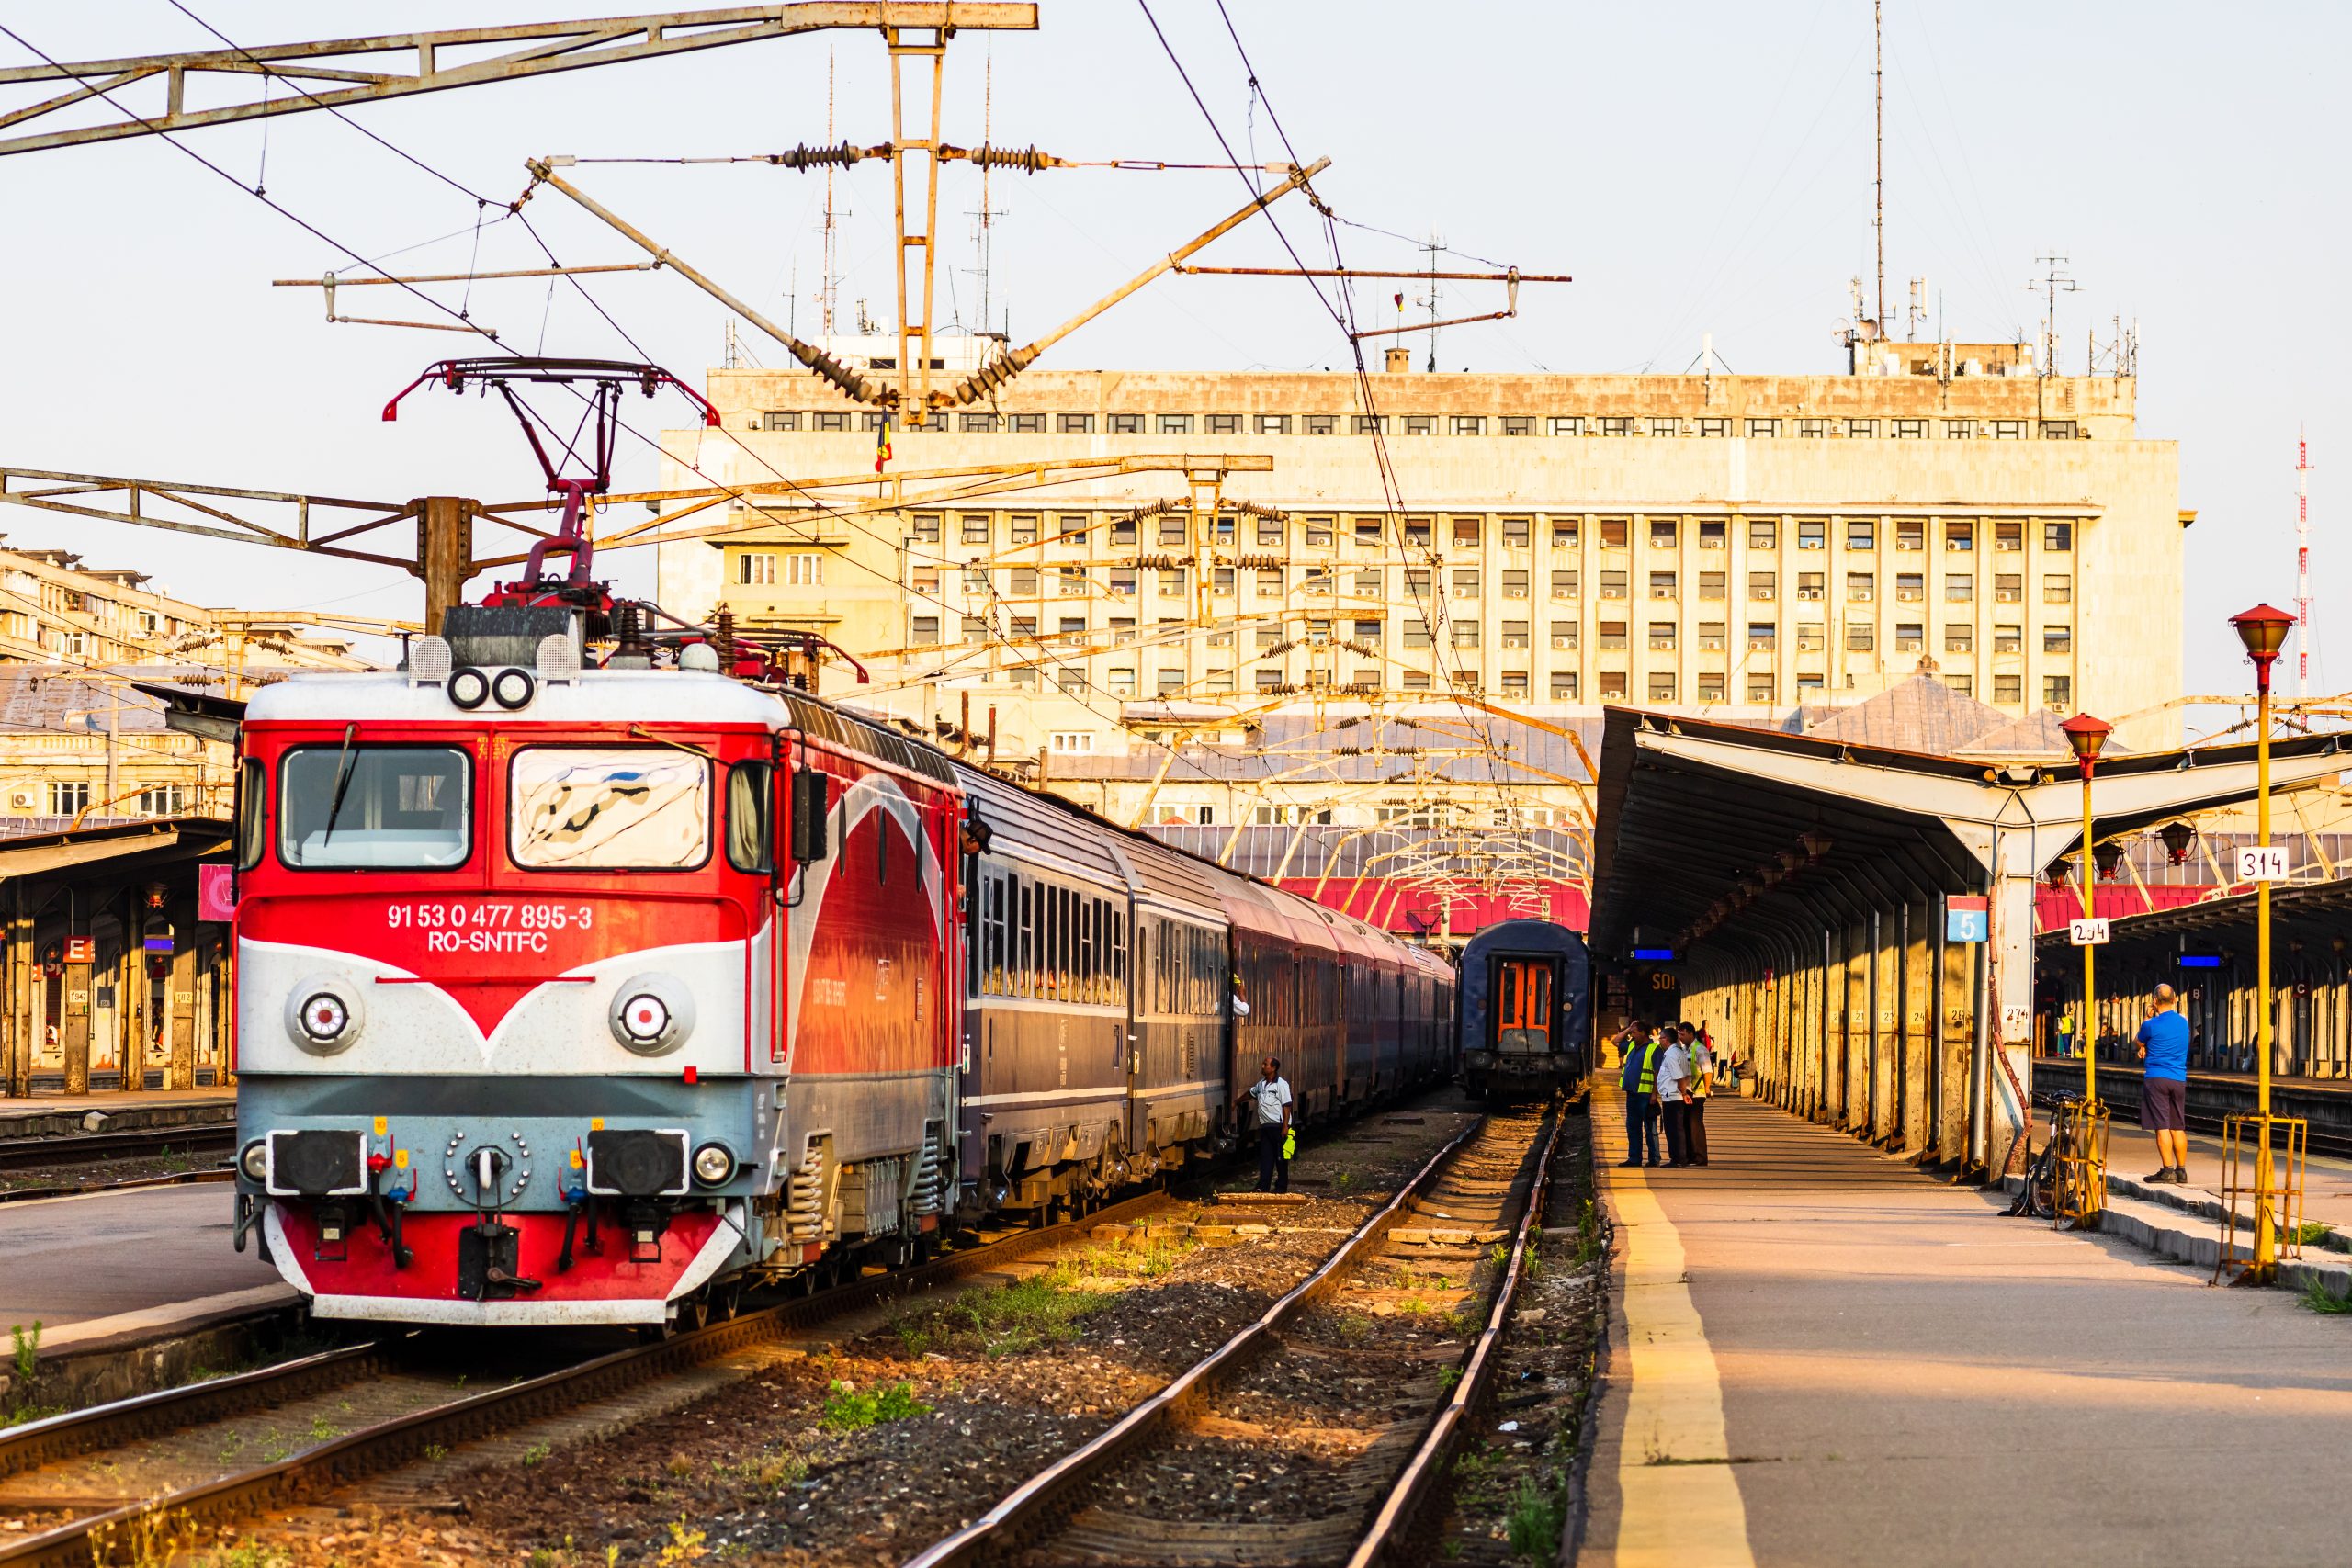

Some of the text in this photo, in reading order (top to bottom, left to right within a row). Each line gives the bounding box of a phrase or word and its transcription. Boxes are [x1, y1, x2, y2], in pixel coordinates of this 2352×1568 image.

[2243, 852, 2281, 876] 314
[388, 904, 593, 930] 91 53 0 477 895-3
[1960, 913, 1975, 940] 5
[428, 931, 548, 953] RO-SNTFC
[70, 940, 85, 959] E
[2176, 957, 2181, 965] 3
[2193, 988, 2200, 998] B
[2297, 983, 2305, 994] C
[376, 1121, 386, 1129] 10
[594, 1122, 604, 1131] 10
[399, 1154, 405, 1163] 5
